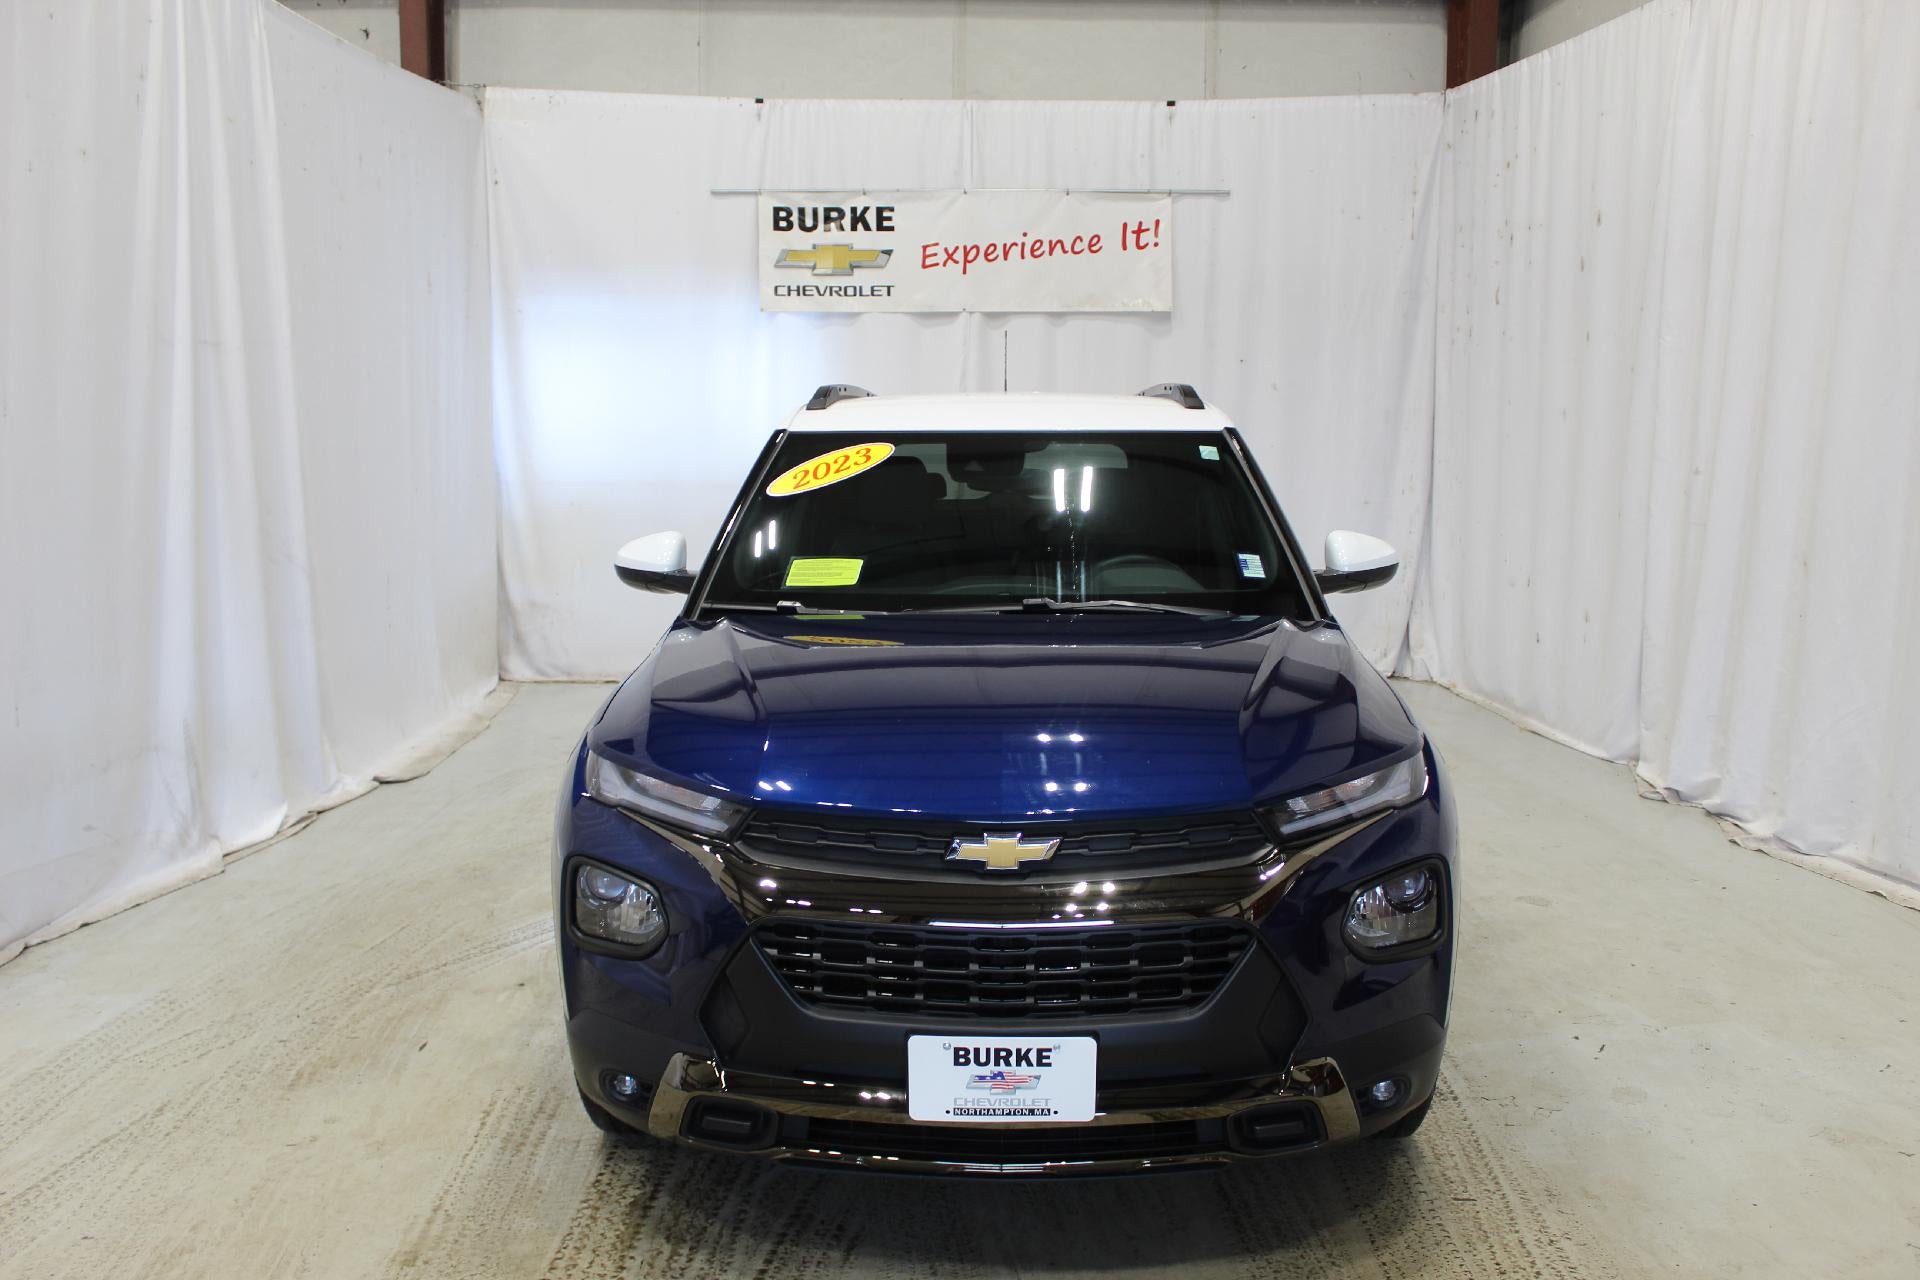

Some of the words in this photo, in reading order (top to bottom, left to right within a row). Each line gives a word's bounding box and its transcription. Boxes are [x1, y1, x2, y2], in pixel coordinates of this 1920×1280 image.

[772, 206, 895, 232] BURKE
[920, 231, 1103, 275] Experience
[1120, 219, 1161, 251] It!
[773, 285, 895, 297] CHEVROLET
[792, 447, 872, 490] 2023
[953, 1047, 1052, 1067] BURKE
[953, 1097, 1052, 1107] CHEVROLET
[1034, 1108, 1050, 1116] MA
